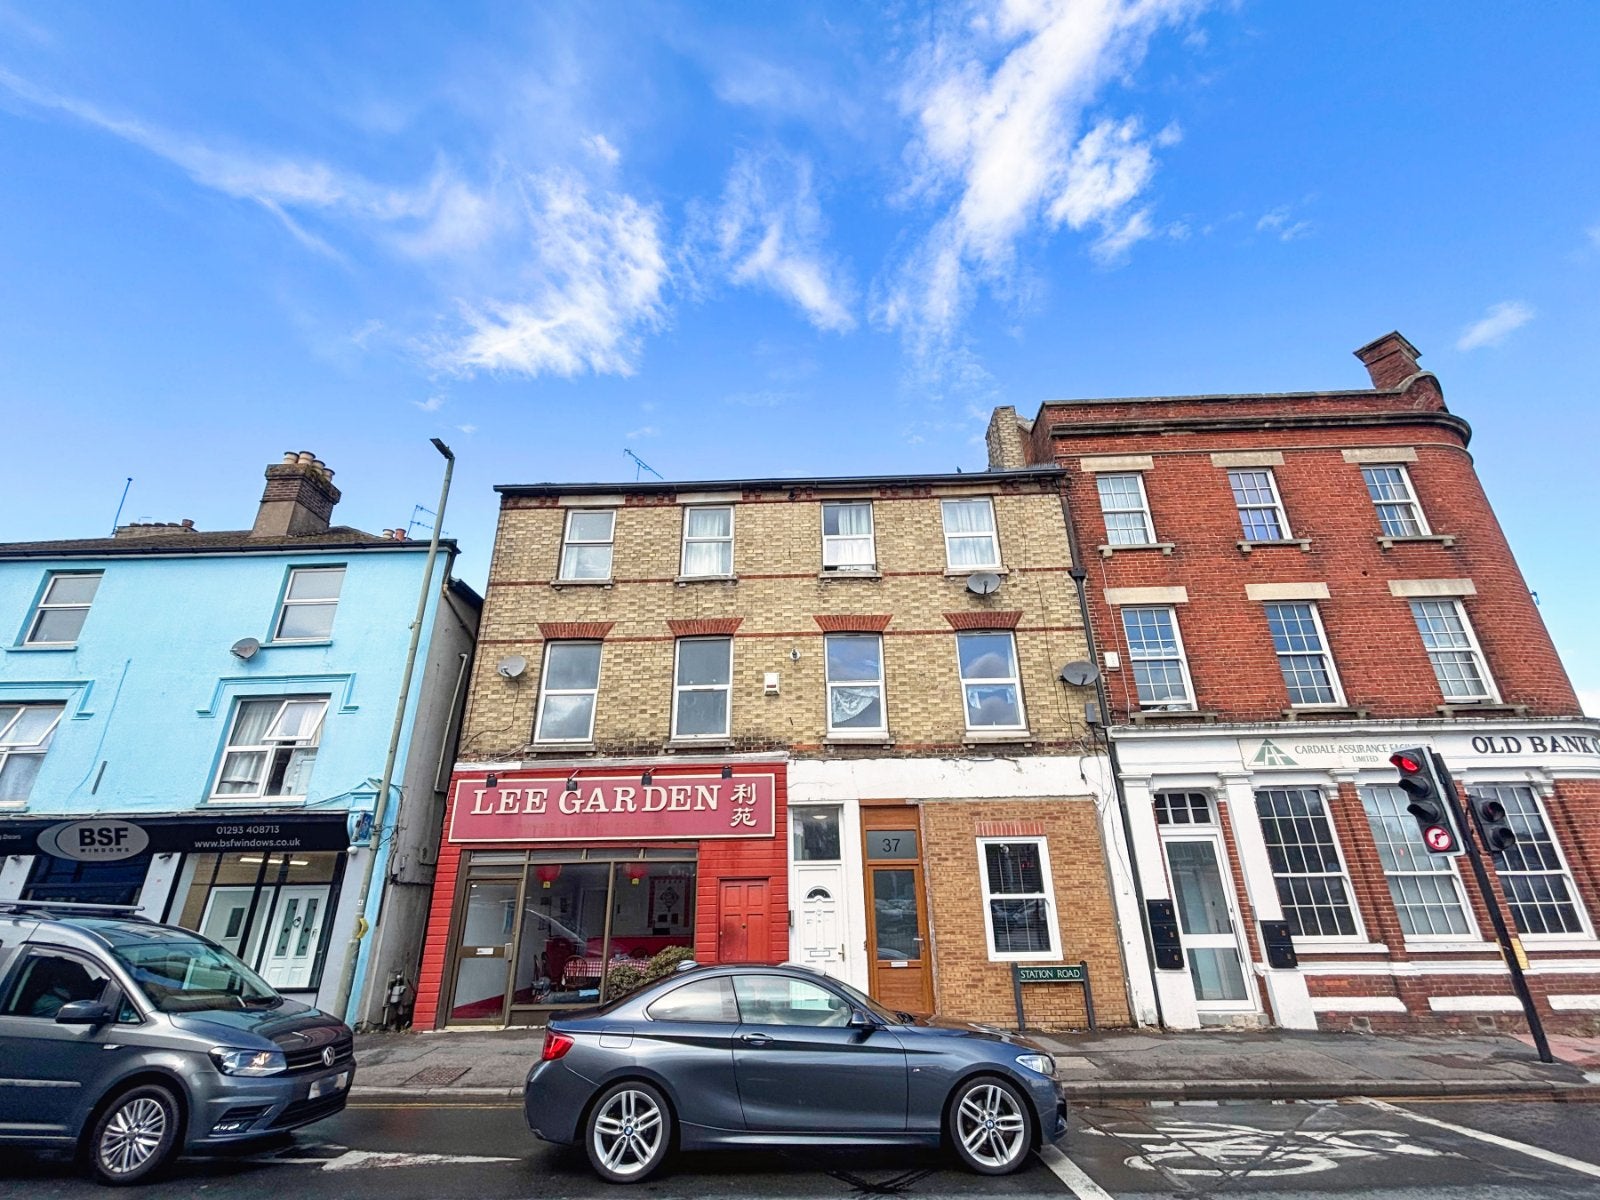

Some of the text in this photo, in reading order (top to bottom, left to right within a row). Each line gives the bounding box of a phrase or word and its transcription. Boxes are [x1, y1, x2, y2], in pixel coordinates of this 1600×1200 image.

[1294, 744, 1336, 755] CARDALE
[1338, 743, 1389, 754] ASSURANCE
[1472, 736, 1522, 754] OLD
[1527, 735, 1594, 754] BANK
[1352, 755, 1379, 763] LIMITED
[470, 785, 721, 815] LEE GARDEN
[730, 782, 757, 827] 利苑
[216, 825, 280, 835] 01293 408713
[79, 827, 129, 847] BSF
[194, 838, 301, 848] www.bsfwindows.co.uk
[882, 838, 901, 853] 37
[1020, 969, 1081, 979] STATION ROAD
